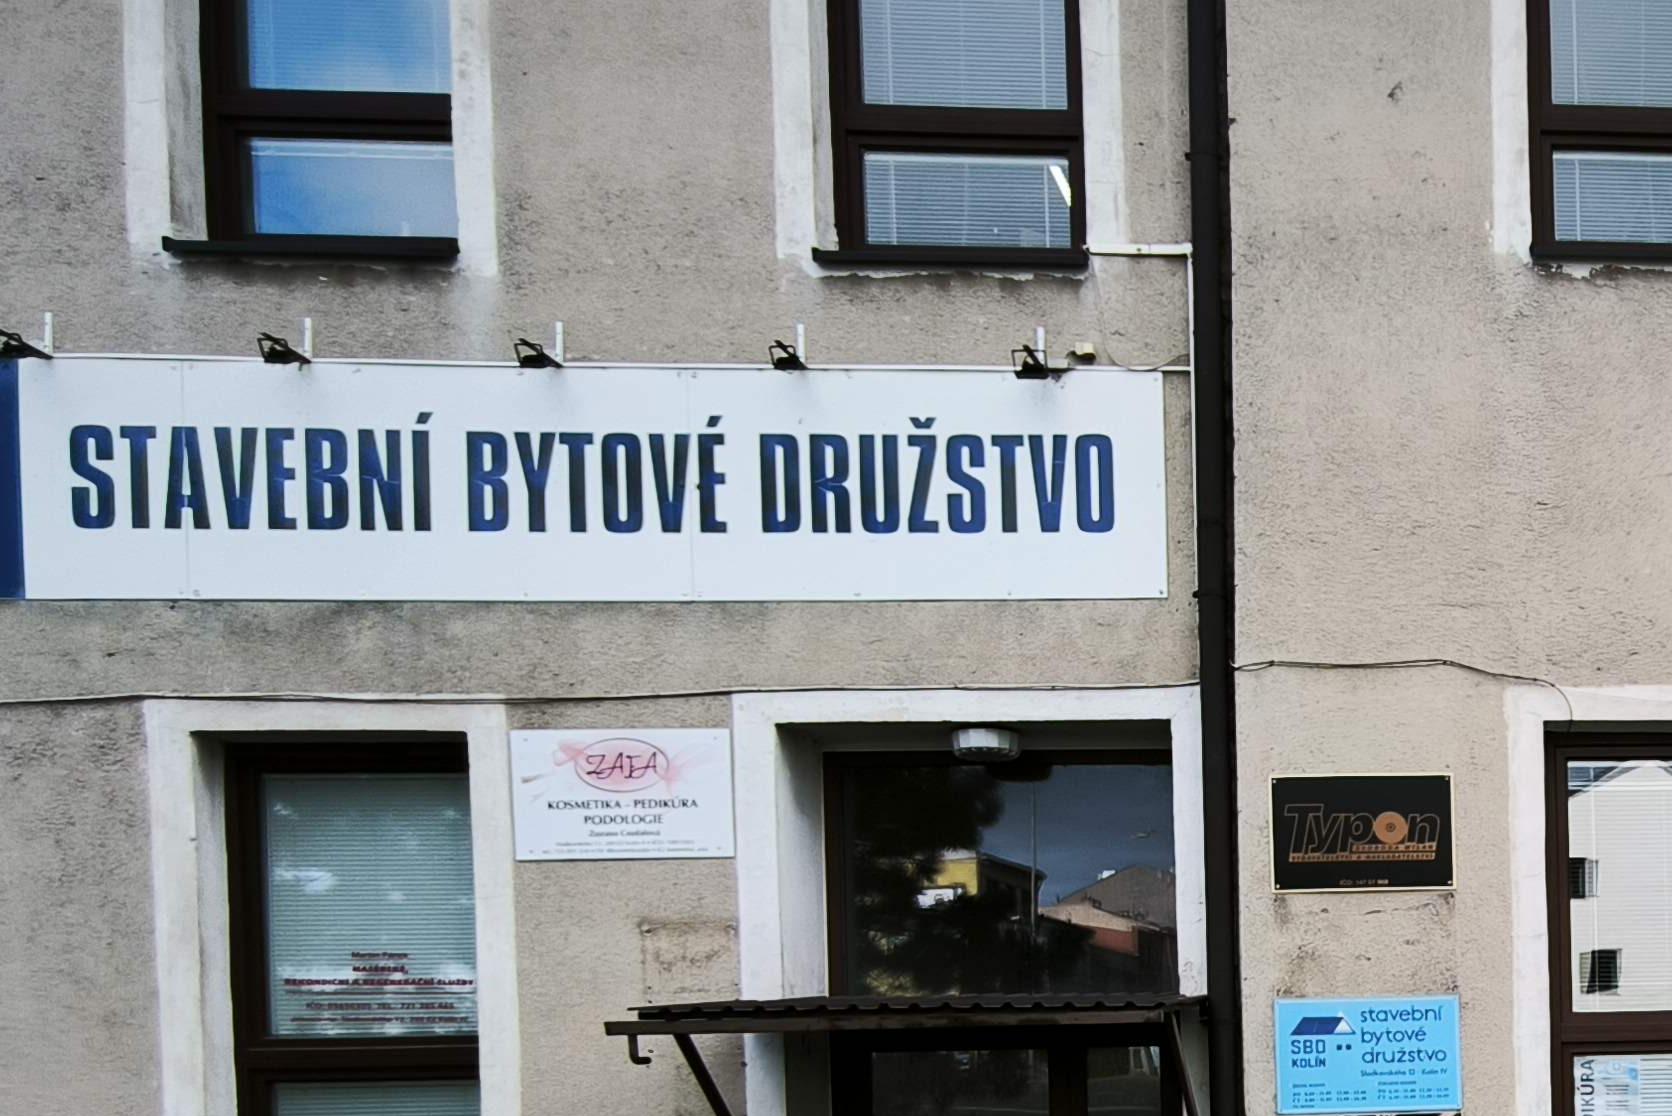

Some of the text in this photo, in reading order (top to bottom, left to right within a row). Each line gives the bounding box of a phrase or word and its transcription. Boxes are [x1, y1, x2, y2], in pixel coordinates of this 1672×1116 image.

[69, 411, 1114, 534] STAVEBNÍ BYTOVÉ DRUŽSTVO
[547, 799, 621, 810] KOSMETIKA
[633, 796, 699, 809] PEDIKÚRA
[583, 814, 664, 826] PODOLOGIE
[1360, 1004, 1444, 1024] stavební
[1360, 1026, 1427, 1046] bytové
[1290, 1039, 1326, 1055] SBD
[1291, 1055, 1326, 1069] KOLÍN
[1361, 1047, 1447, 1064] družstvo
